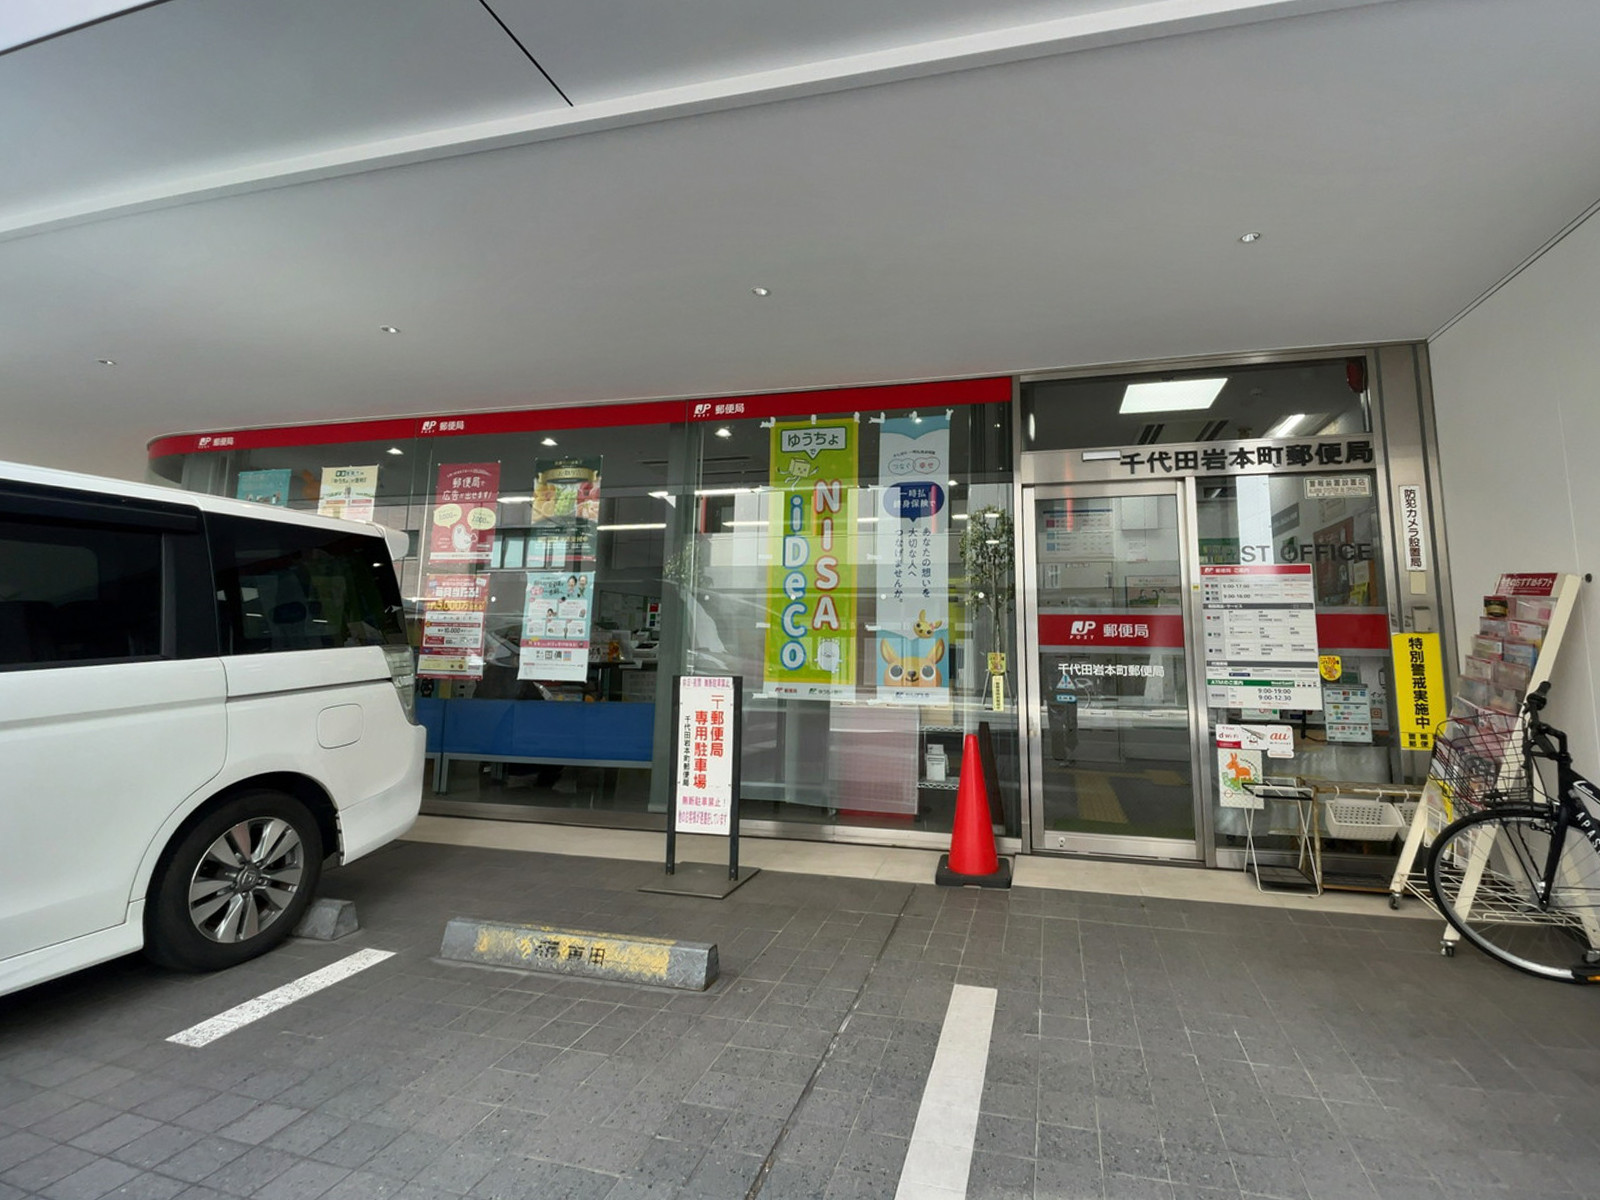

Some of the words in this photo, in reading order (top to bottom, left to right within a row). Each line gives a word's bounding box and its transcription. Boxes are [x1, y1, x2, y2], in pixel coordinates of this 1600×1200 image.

[439, 421, 465, 431] 郵便局
[715, 403, 745, 415] 郵便局
[213, 436, 234, 446] 郵便局
[787, 431, 840, 447] ゆうちょ
[1120, 440, 1374, 475] 千代田岩本町郵便局
[452, 477, 485, 488] 郵便局で
[900, 489, 926, 497] 一時払
[1404, 489, 1422, 567] 防犯カメラ設置局
[812, 479, 842, 631] NISA
[894, 529, 904, 602] つなげませんか。
[908, 527, 918, 577] 大切な人へ
[922, 527, 931, 598] あなたの想いを
[1280, 543, 1373, 563] OFFICE
[780, 494, 810, 671] iDeCo
[1071, 620, 1096, 634] JP
[1103, 624, 1149, 638] 郵便局
[1058, 663, 1165, 678] 千代田岩本町郵便局
[1408, 637, 1430, 729] 特別警戒実施中
[682, 715, 691, 787] 千代田岩本町郵便局
[693, 710, 708, 790] 専用駐車場
[1269, 732, 1290, 740] au
[1575, 811, 1600, 856] APAS
